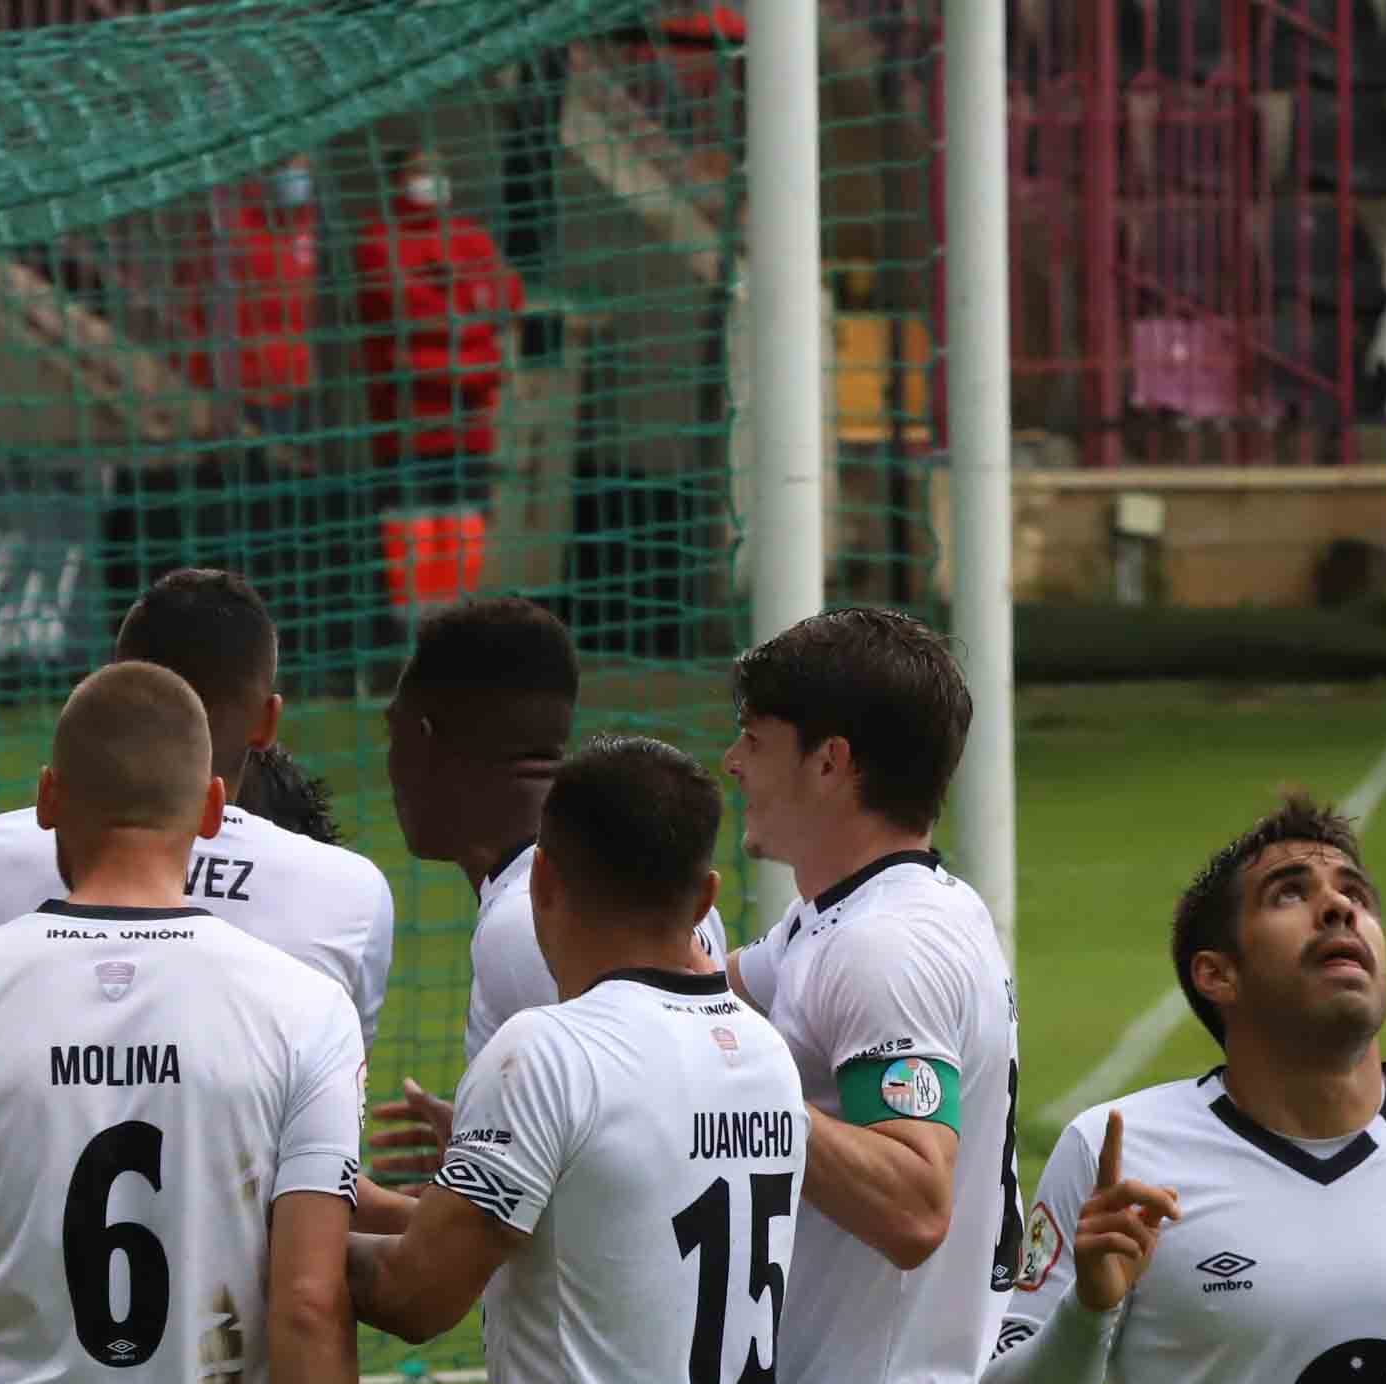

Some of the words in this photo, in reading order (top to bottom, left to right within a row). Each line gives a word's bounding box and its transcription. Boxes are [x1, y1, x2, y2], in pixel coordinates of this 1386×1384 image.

[50, 1044, 182, 1087] MOLINA
[689, 1110, 794, 1160] JUANCHO
[62, 1119, 171, 1368] 6
[1202, 1279, 1254, 1293] umbro
